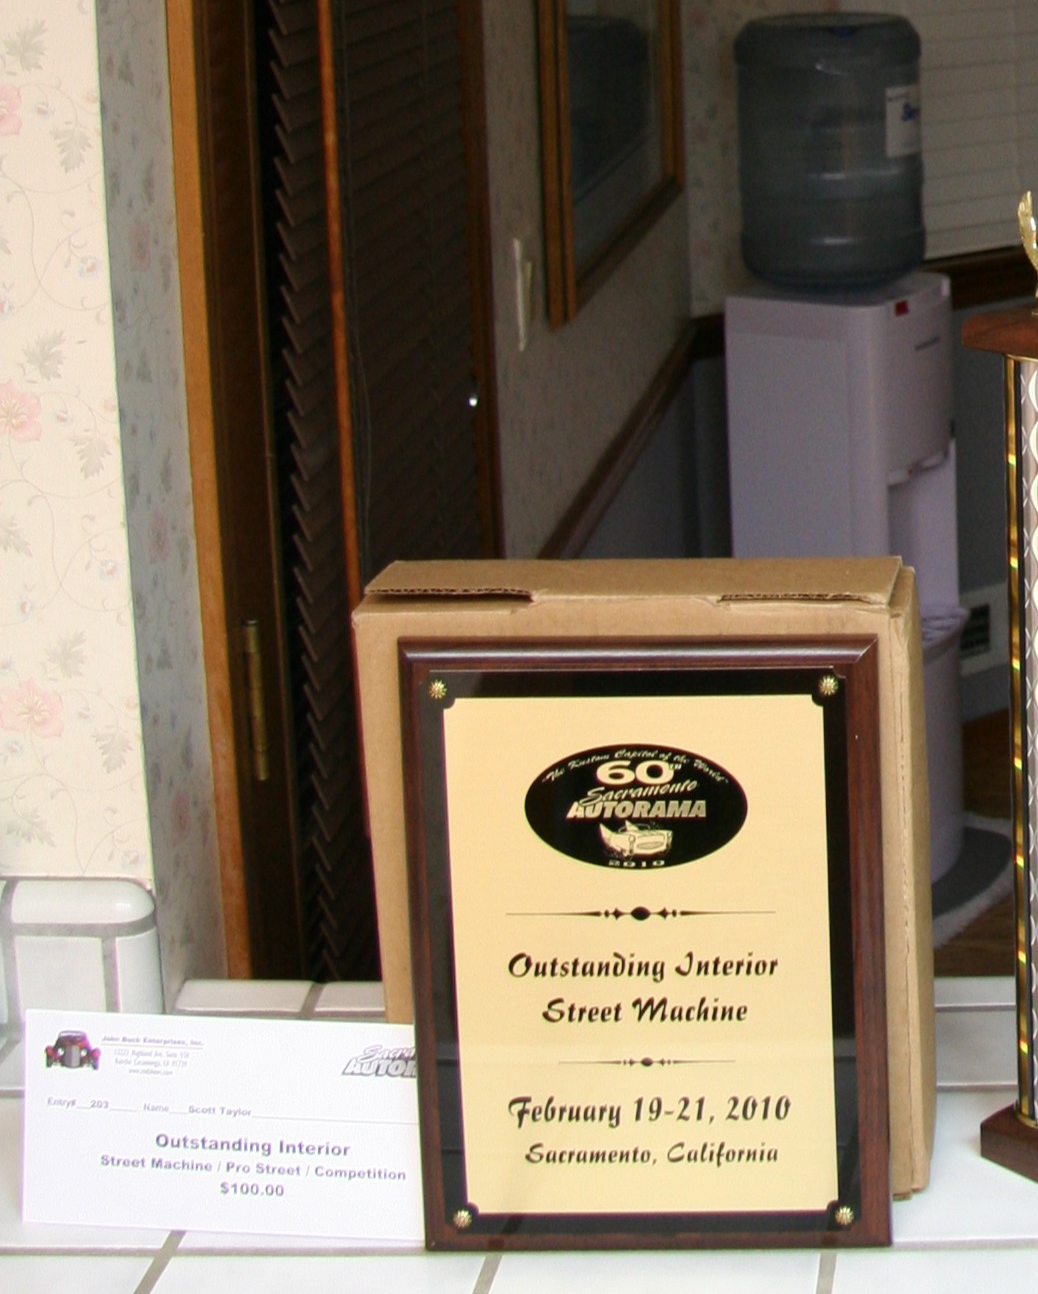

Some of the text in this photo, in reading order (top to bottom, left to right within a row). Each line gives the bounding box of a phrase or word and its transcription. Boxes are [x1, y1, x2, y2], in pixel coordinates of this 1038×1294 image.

[659, 751, 670, 761] of
[673, 752, 690, 764] the
[579, 779, 699, 807] Sacramento
[566, 799, 707, 819] AUTORAMA
[608, 859, 665, 869] 2010
[508, 951, 779, 983] Outstanding Interior
[542, 996, 748, 1024] Street Machine
[90, 1100, 109, 1109] 203
[143, 1103, 169, 1112] Name
[188, 1105, 216, 1114] Scott
[220, 1106, 252, 1118] Taylor
[508, 1095, 791, 1129] February 19-21, 2010
[155, 1133, 350, 1157] Outstanding Interior
[525, 1142, 779, 1167] Sacramento, California
[100, 1154, 146, 1169] Street
[151, 1157, 213, 1172] Machine
[226, 1162, 250, 1175] Pro
[256, 1162, 301, 1176] Street
[314, 1165, 407, 1182] Competition
[220, 1181, 285, 1197] $100.00
